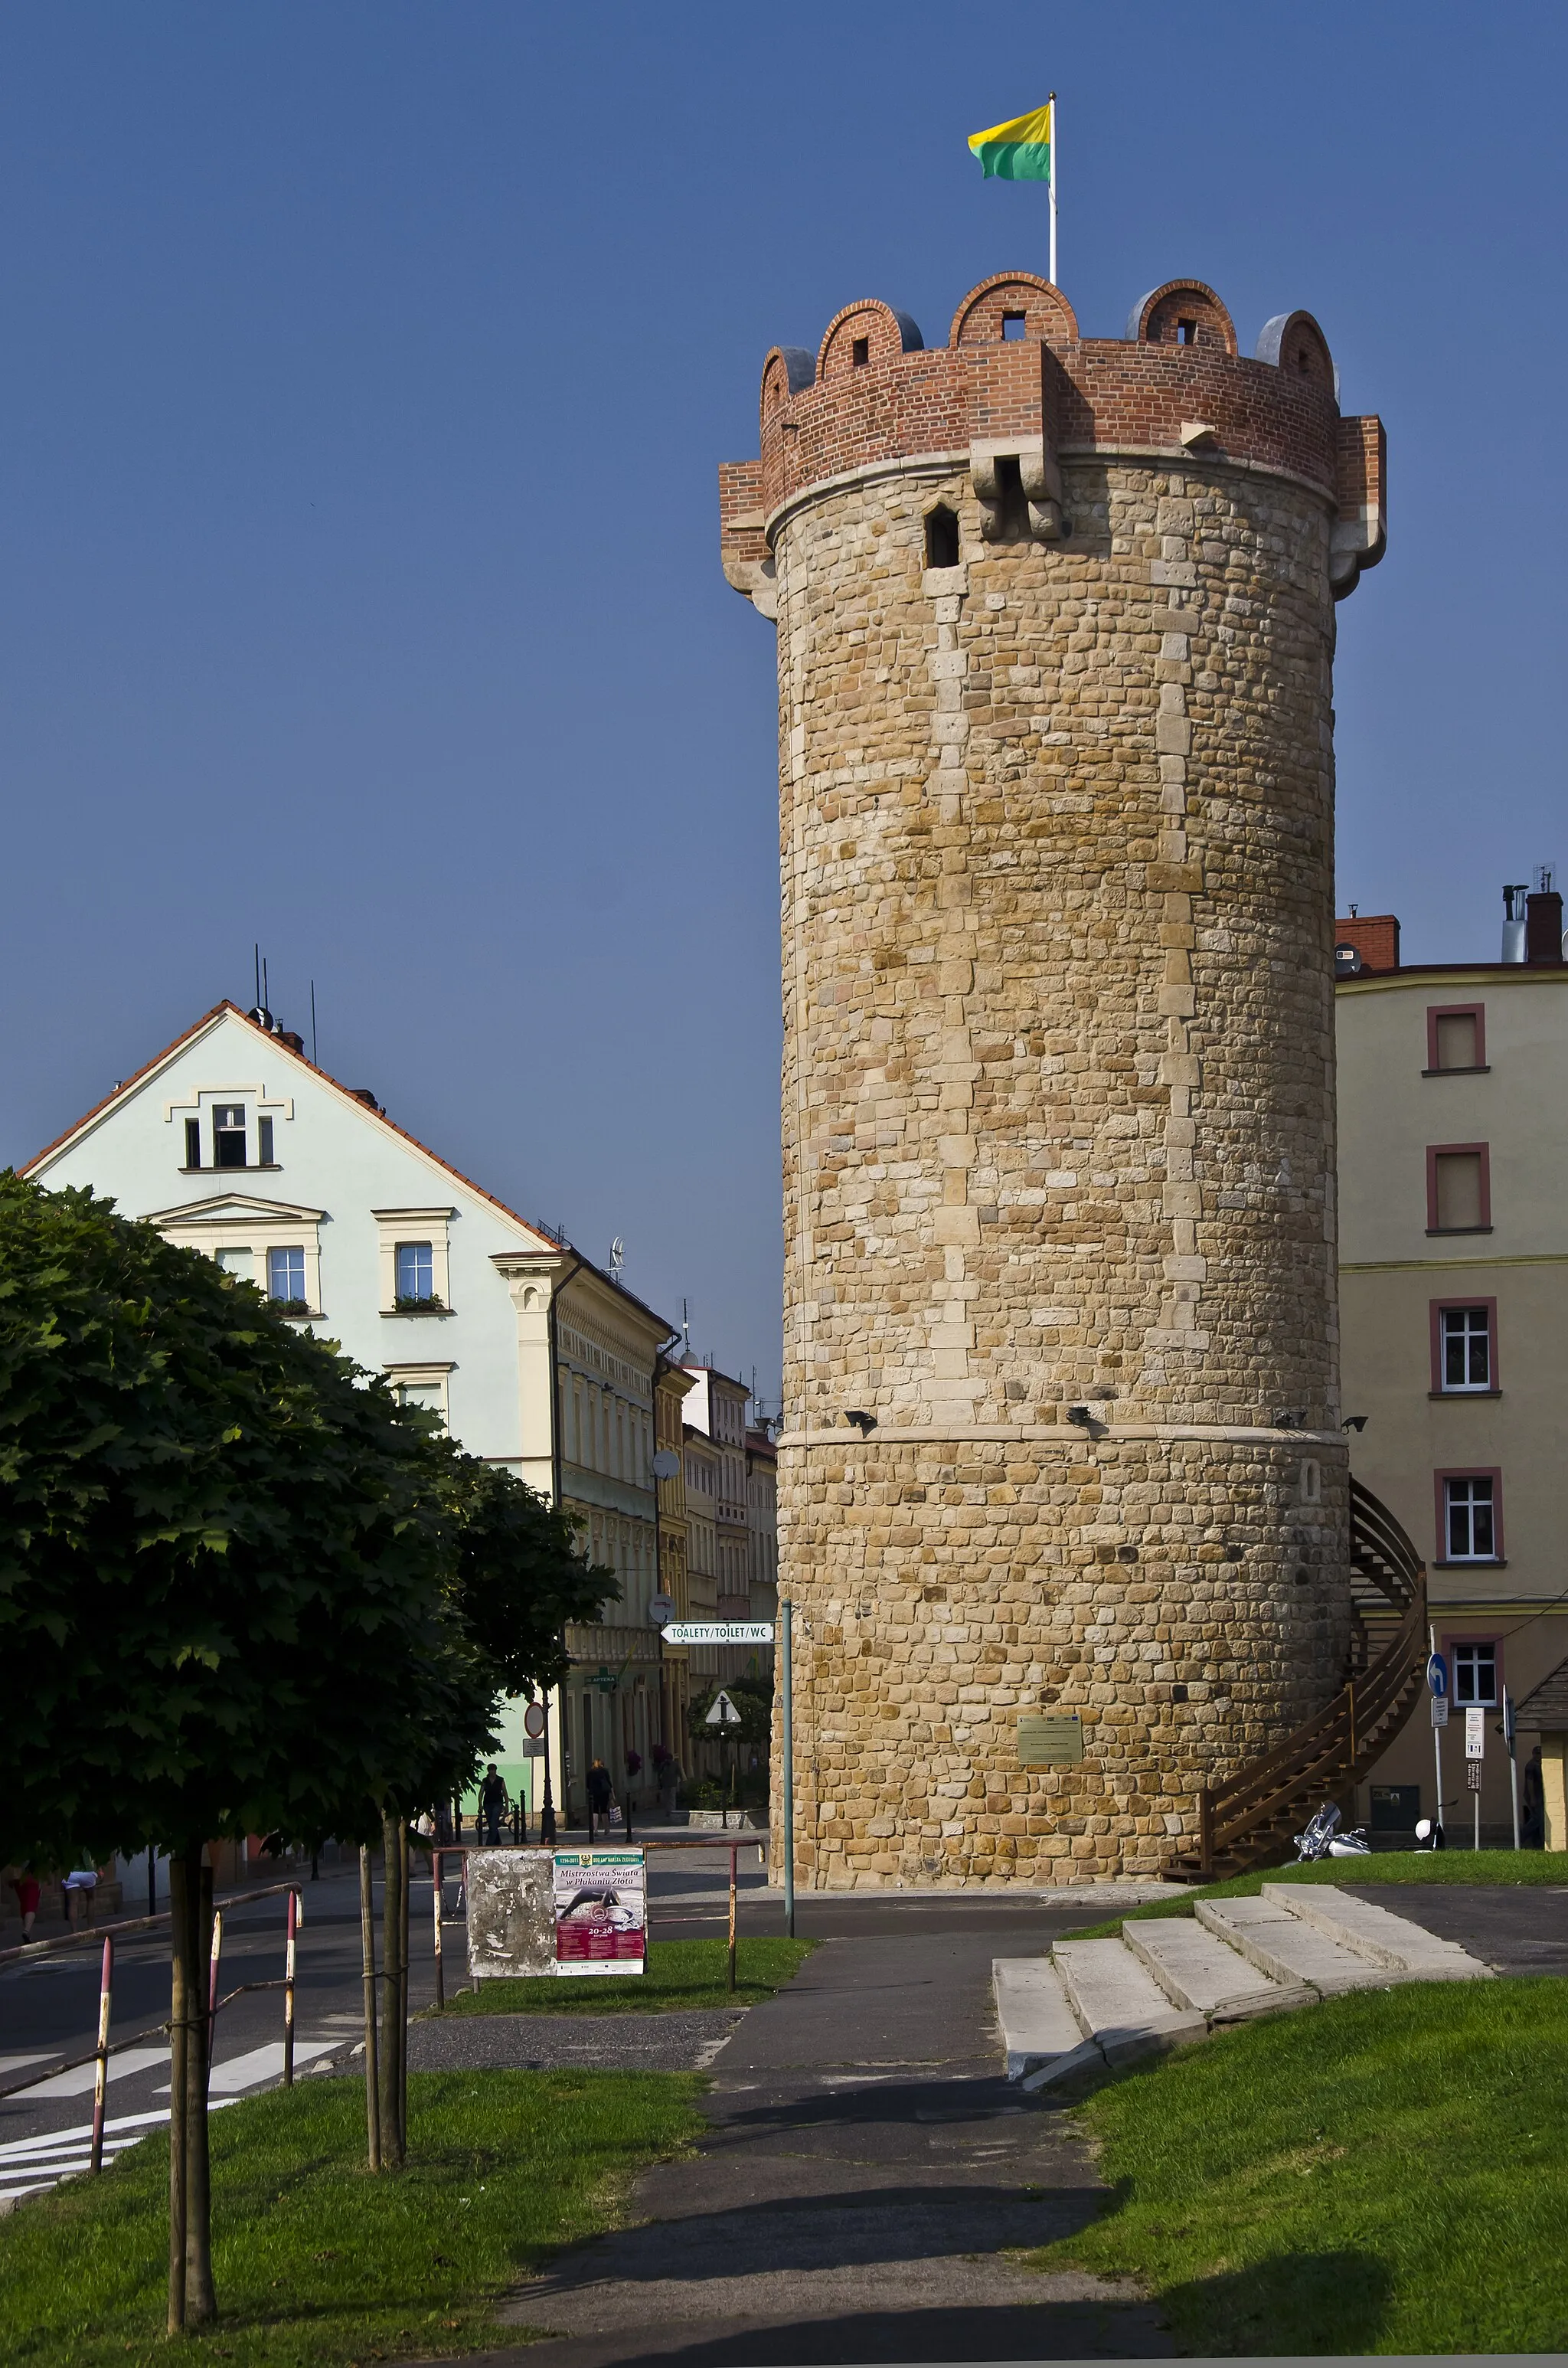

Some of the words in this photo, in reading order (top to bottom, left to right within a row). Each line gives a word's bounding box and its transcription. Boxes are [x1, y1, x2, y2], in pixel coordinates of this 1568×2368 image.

[671, 1627, 766, 1638] TOALETY/TOILET/WC
[612, 1868, 639, 1876] Świata
[588, 1925, 613, 1935] 20-28
